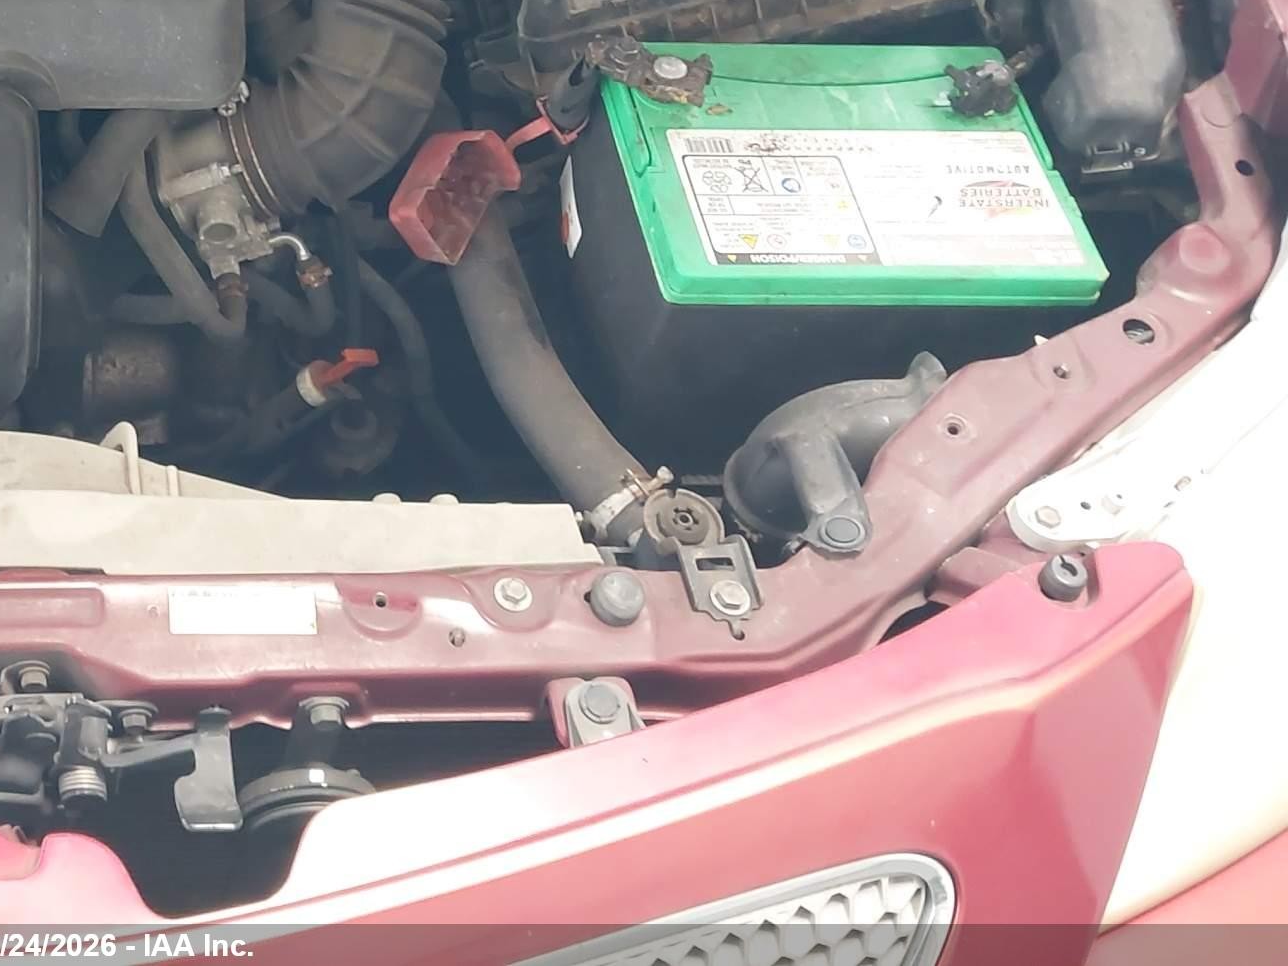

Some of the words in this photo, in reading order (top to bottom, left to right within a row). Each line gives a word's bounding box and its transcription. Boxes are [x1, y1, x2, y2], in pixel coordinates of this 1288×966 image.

[945, 165, 1030, 174] AUTOMOTIVE
[960, 188, 1042, 197] BATTERIES
[959, 198, 1049, 207] INTERSTATE
